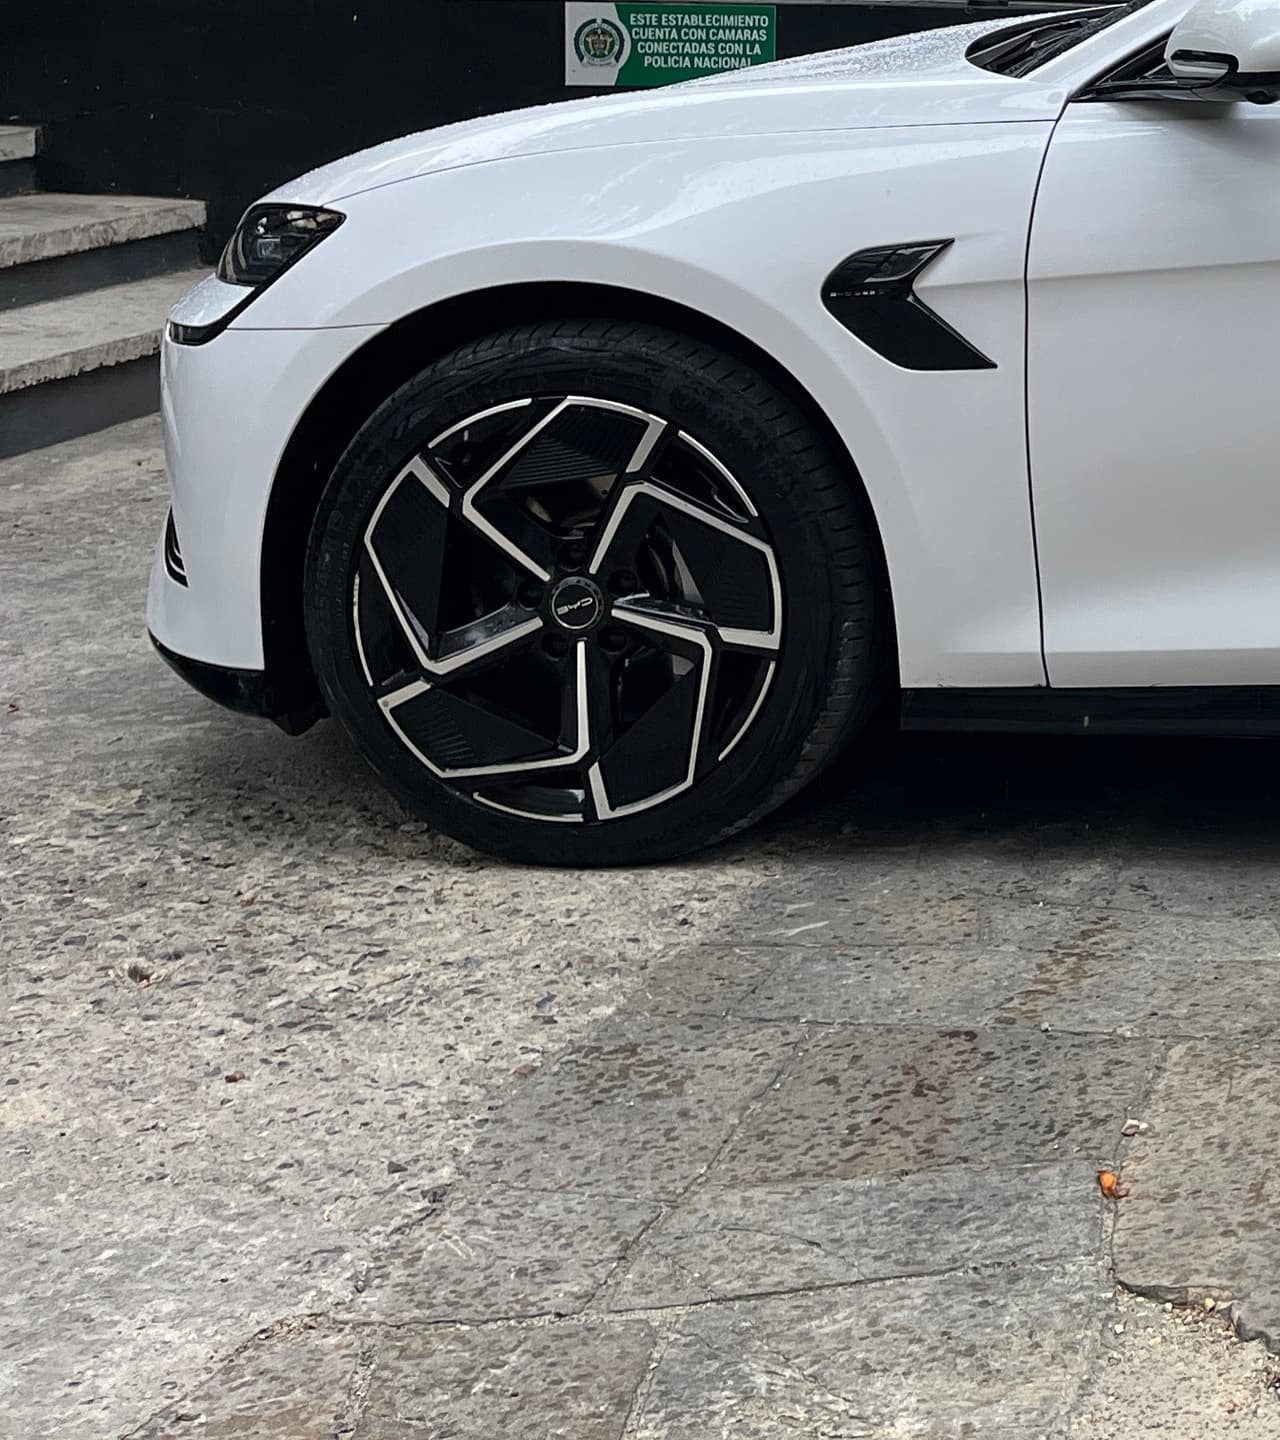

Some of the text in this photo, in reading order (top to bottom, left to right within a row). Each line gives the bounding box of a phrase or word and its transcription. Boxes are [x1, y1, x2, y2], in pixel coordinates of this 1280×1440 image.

[629, 13, 769, 27] ESTE ESTABLECIMIENTO
[631, 28, 767, 41] CUENTA CON CAMARAS
[637, 42, 762, 55] CONECTADAS CON LA
[644, 56, 692, 68] POLICIA
